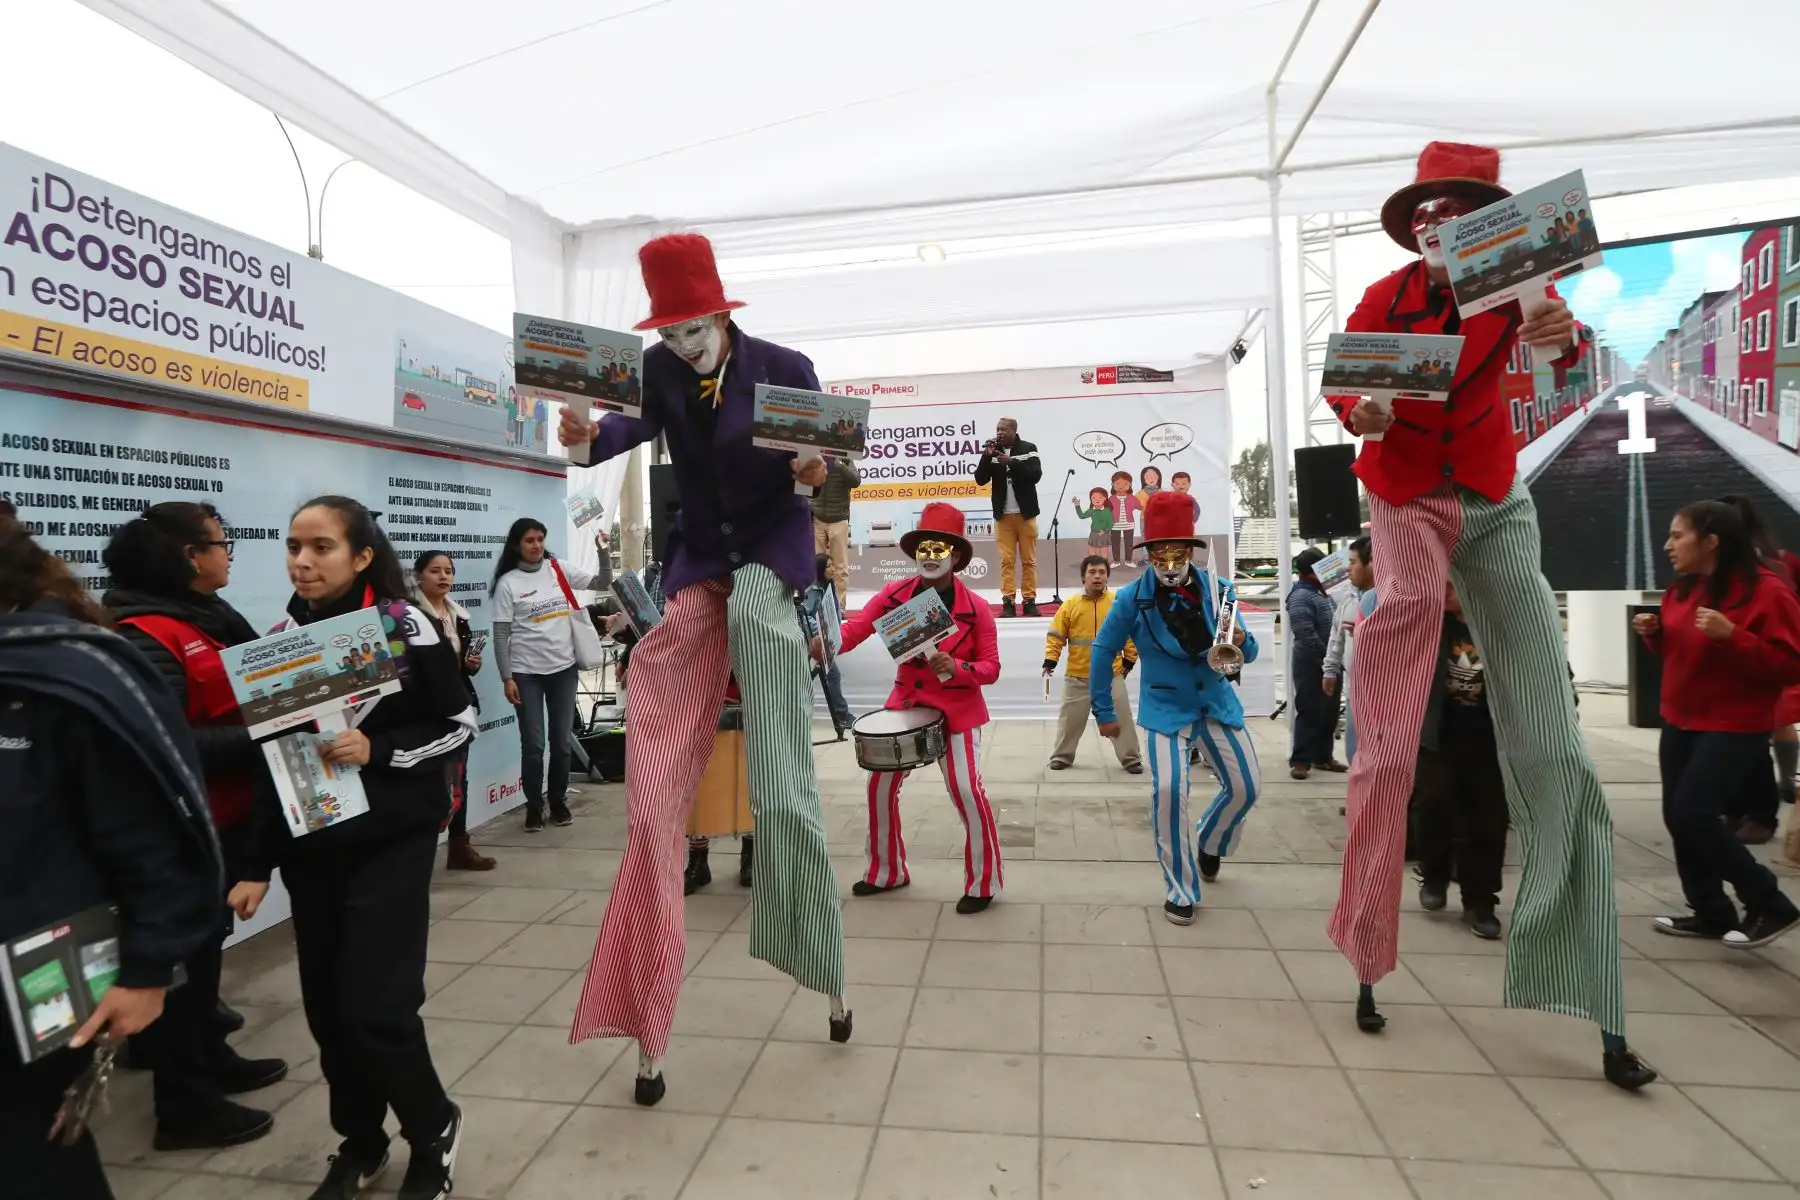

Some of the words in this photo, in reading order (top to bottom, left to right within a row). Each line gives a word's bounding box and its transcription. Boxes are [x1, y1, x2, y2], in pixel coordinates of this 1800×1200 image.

[31, 172, 262, 280] ¡Detengamos
[270, 262, 291, 289] el
[1455, 224, 1485, 241] ACOSO
[1487, 210, 1522, 228] SEXUAL
[4, 211, 167, 288] ACOSO
[179, 267, 304, 330] SEXUAL
[31, 276, 199, 341] espacios
[209, 321, 326, 372] públicos!
[525, 326, 553, 338] ACOSO
[556, 332, 586, 344] SEXUAL
[33, 325, 63, 356] El
[72, 341, 157, 375] acoso
[165, 360, 193, 382] es
[201, 365, 289, 402] violencia
[1098, 371, 1115, 379] PERÚ
[846, 385, 870, 396] PERÚ
[872, 384, 915, 395] PRIMERO
[866, 424, 955, 443] tengamos
[960, 420, 976, 436] el
[1614, 391, 1656, 454] 1
[2, 433, 49, 452] ACOSO
[52, 438, 98, 457] SEXUAL
[100, 443, 114, 459] EN
[117, 446, 169, 464] ESPACIOS
[171, 451, 217, 470] PÚBLICOS
[219, 457, 230, 470] ES
[904, 440, 984, 457] SEXUAL
[23, 463, 51, 480] UNA
[54, 466, 119, 486] SITUACIÓN
[122, 472, 135, 486] DE
[137, 473, 172, 489] ACOSO
[174, 476, 209, 492] SEXUAL
[211, 480, 223, 493] YO
[858, 463, 916, 480] pacios
[922, 460, 978, 480] públic
[395, 478, 414, 489] ACOSO
[414, 480, 433, 491] SEXUAL
[441, 483, 465, 494] ESPACIOS
[853, 489, 894, 499] acoso
[898, 487, 913, 497] es
[918, 484, 977, 498] violencia
[15, 491, 79, 510] SILBIDOS,
[82, 495, 99, 511] ME
[102, 496, 150, 512] GENERAN
[388, 495, 402, 506] ANTE
[450, 500, 467, 511] ACOSO
[388, 513, 398, 524] LOS
[48, 521, 65, 536] ME
[222, 527, 266, 540] SOCIEDAD
[268, 528, 280, 540] ME
[411, 532, 419, 542] ME
[420, 532, 441, 542] ACOSAN
[441, 532, 449, 543] ME
[871, 566, 917, 575] Emergencia
[241, 650, 276, 666] ACOSO
[278, 638, 316, 655] SEXUAL
